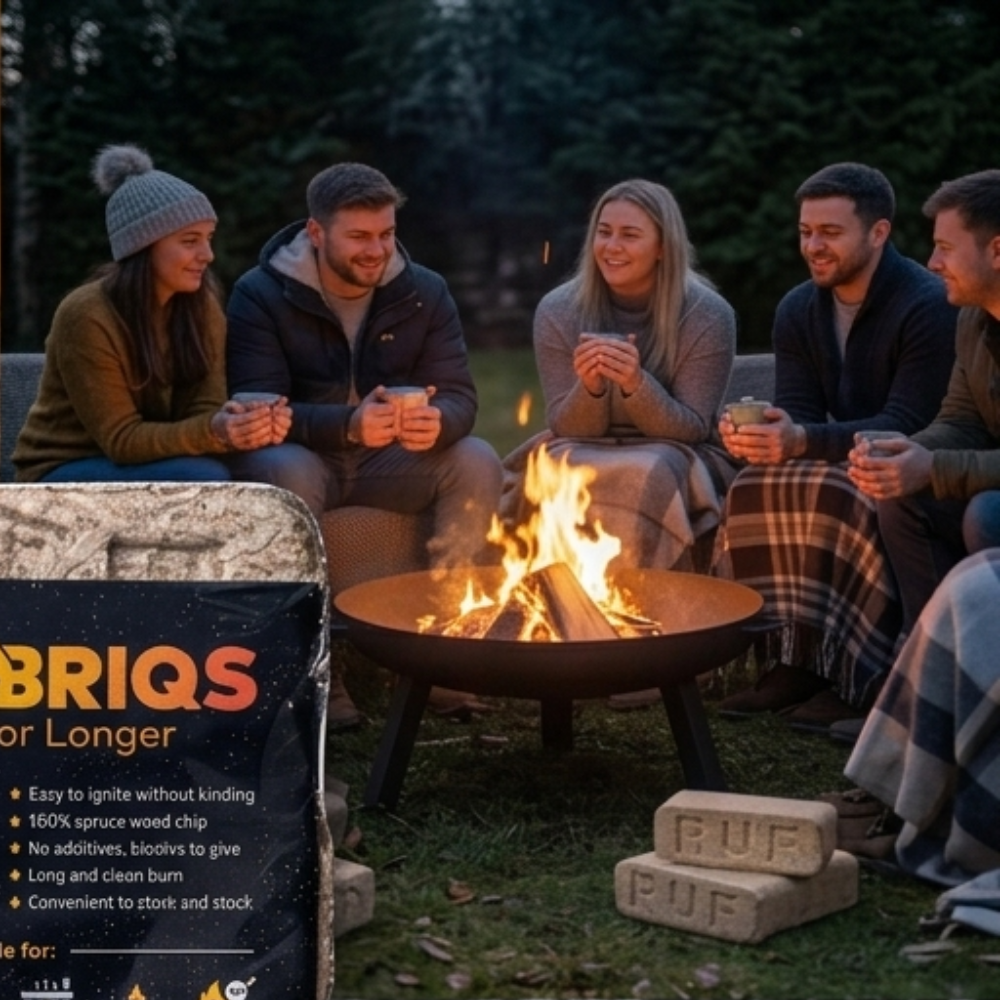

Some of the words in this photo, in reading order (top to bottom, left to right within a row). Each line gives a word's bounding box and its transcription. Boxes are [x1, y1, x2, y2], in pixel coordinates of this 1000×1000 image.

[45, 717, 177, 757] Longer
[28, 787, 61, 804] Easy
[68, 788, 83, 801] to
[88, 787, 131, 805] ignite
[136, 787, 194, 801] without
[199, 787, 255, 805] kinding
[74, 815, 125, 831] spruce
[175, 814, 207, 831] chip
[29, 842, 49, 855] No
[189, 843, 205, 855] to
[209, 841, 241, 860] give
[28, 868, 65, 885] Long
[70, 868, 98, 882] and
[28, 895, 113, 909] Convenient
[118, 896, 133, 909] to
[181, 895, 208, 909] and
[212, 895, 253, 909] stock
[21, 941, 56, 959] for:
